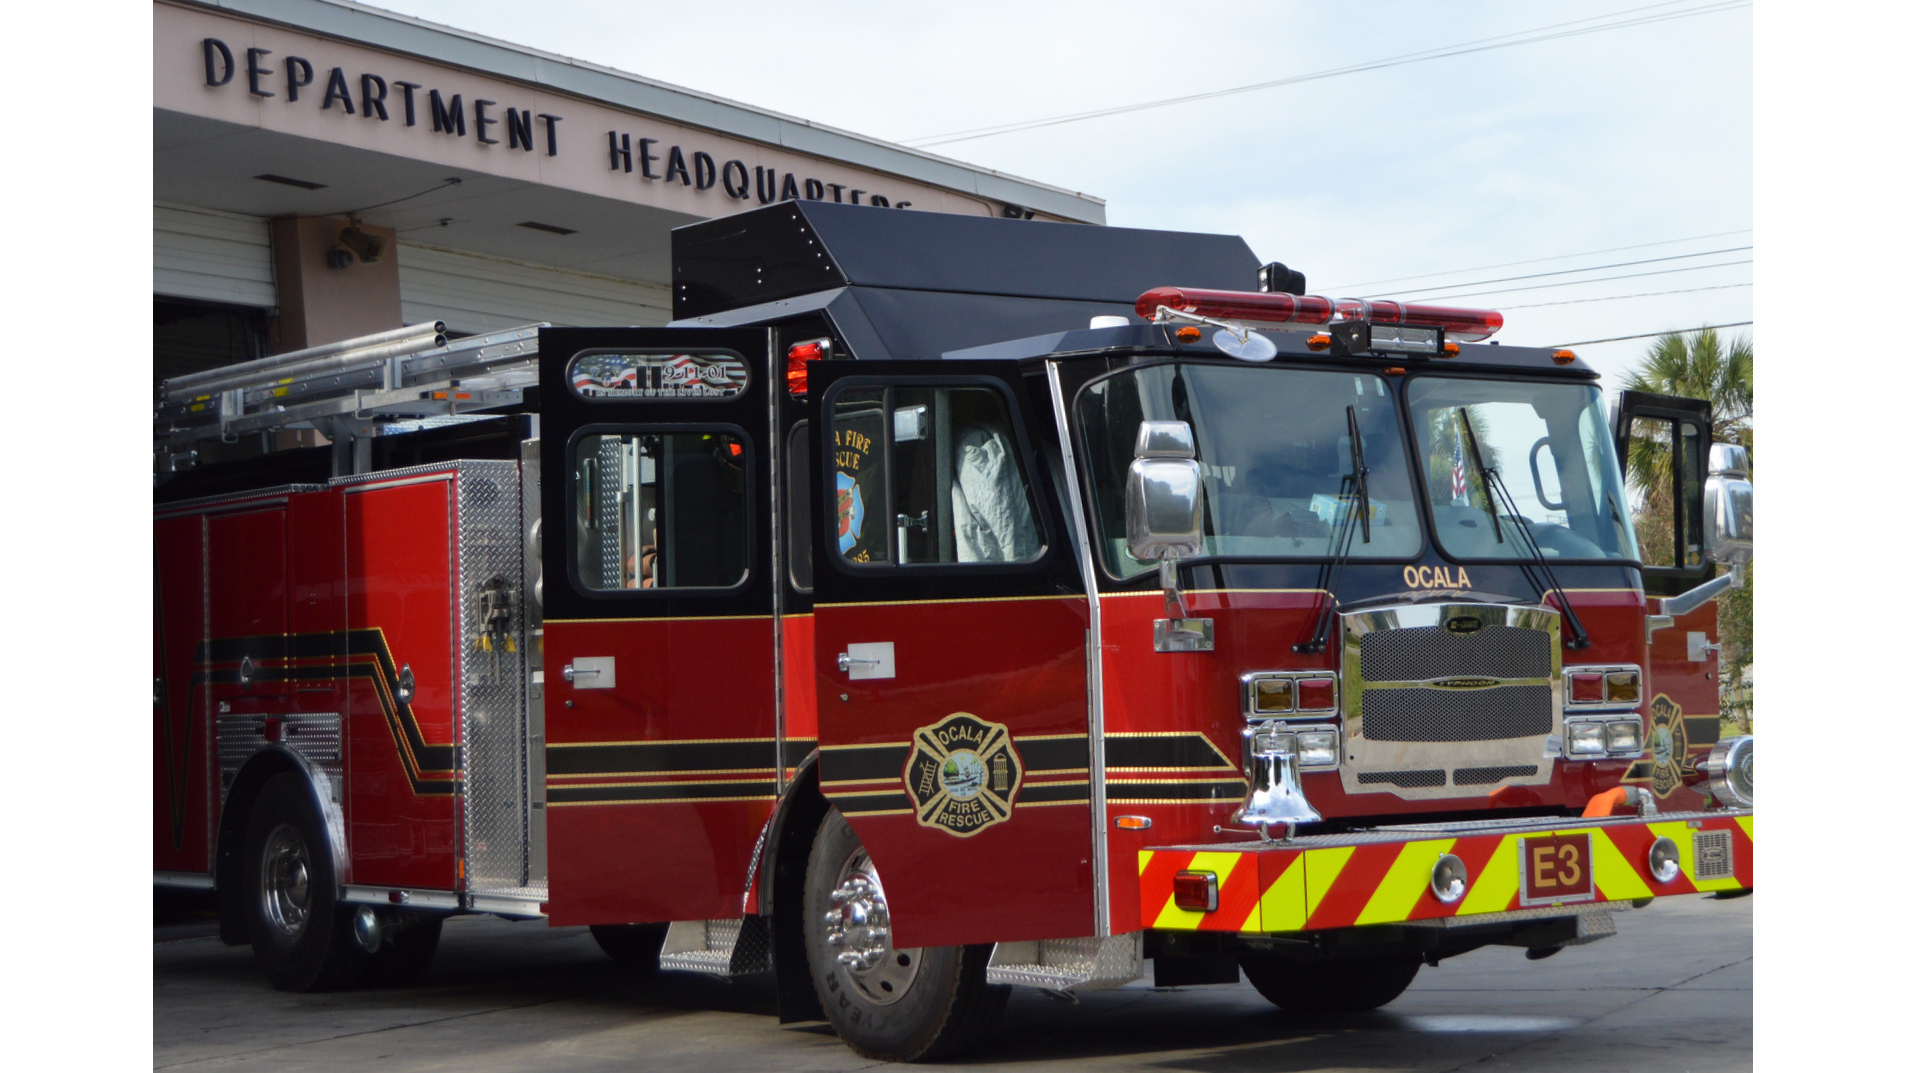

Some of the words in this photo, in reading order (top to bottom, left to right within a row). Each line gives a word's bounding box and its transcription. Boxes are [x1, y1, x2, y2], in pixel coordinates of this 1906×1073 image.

[202, 37, 563, 156] DEPARTMENT
[608, 130, 912, 209] HEADQUART
[664, 365, 727, 379] 9-11-01
[659, 388, 676, 397] THE
[845, 429, 871, 455] FIRE
[1403, 565, 1472, 588] OCALA
[938, 725, 984, 745] OCALA
[948, 800, 980, 814] FIRE
[939, 810, 991, 827] RESCUE
[1532, 844, 1581, 888] E3
